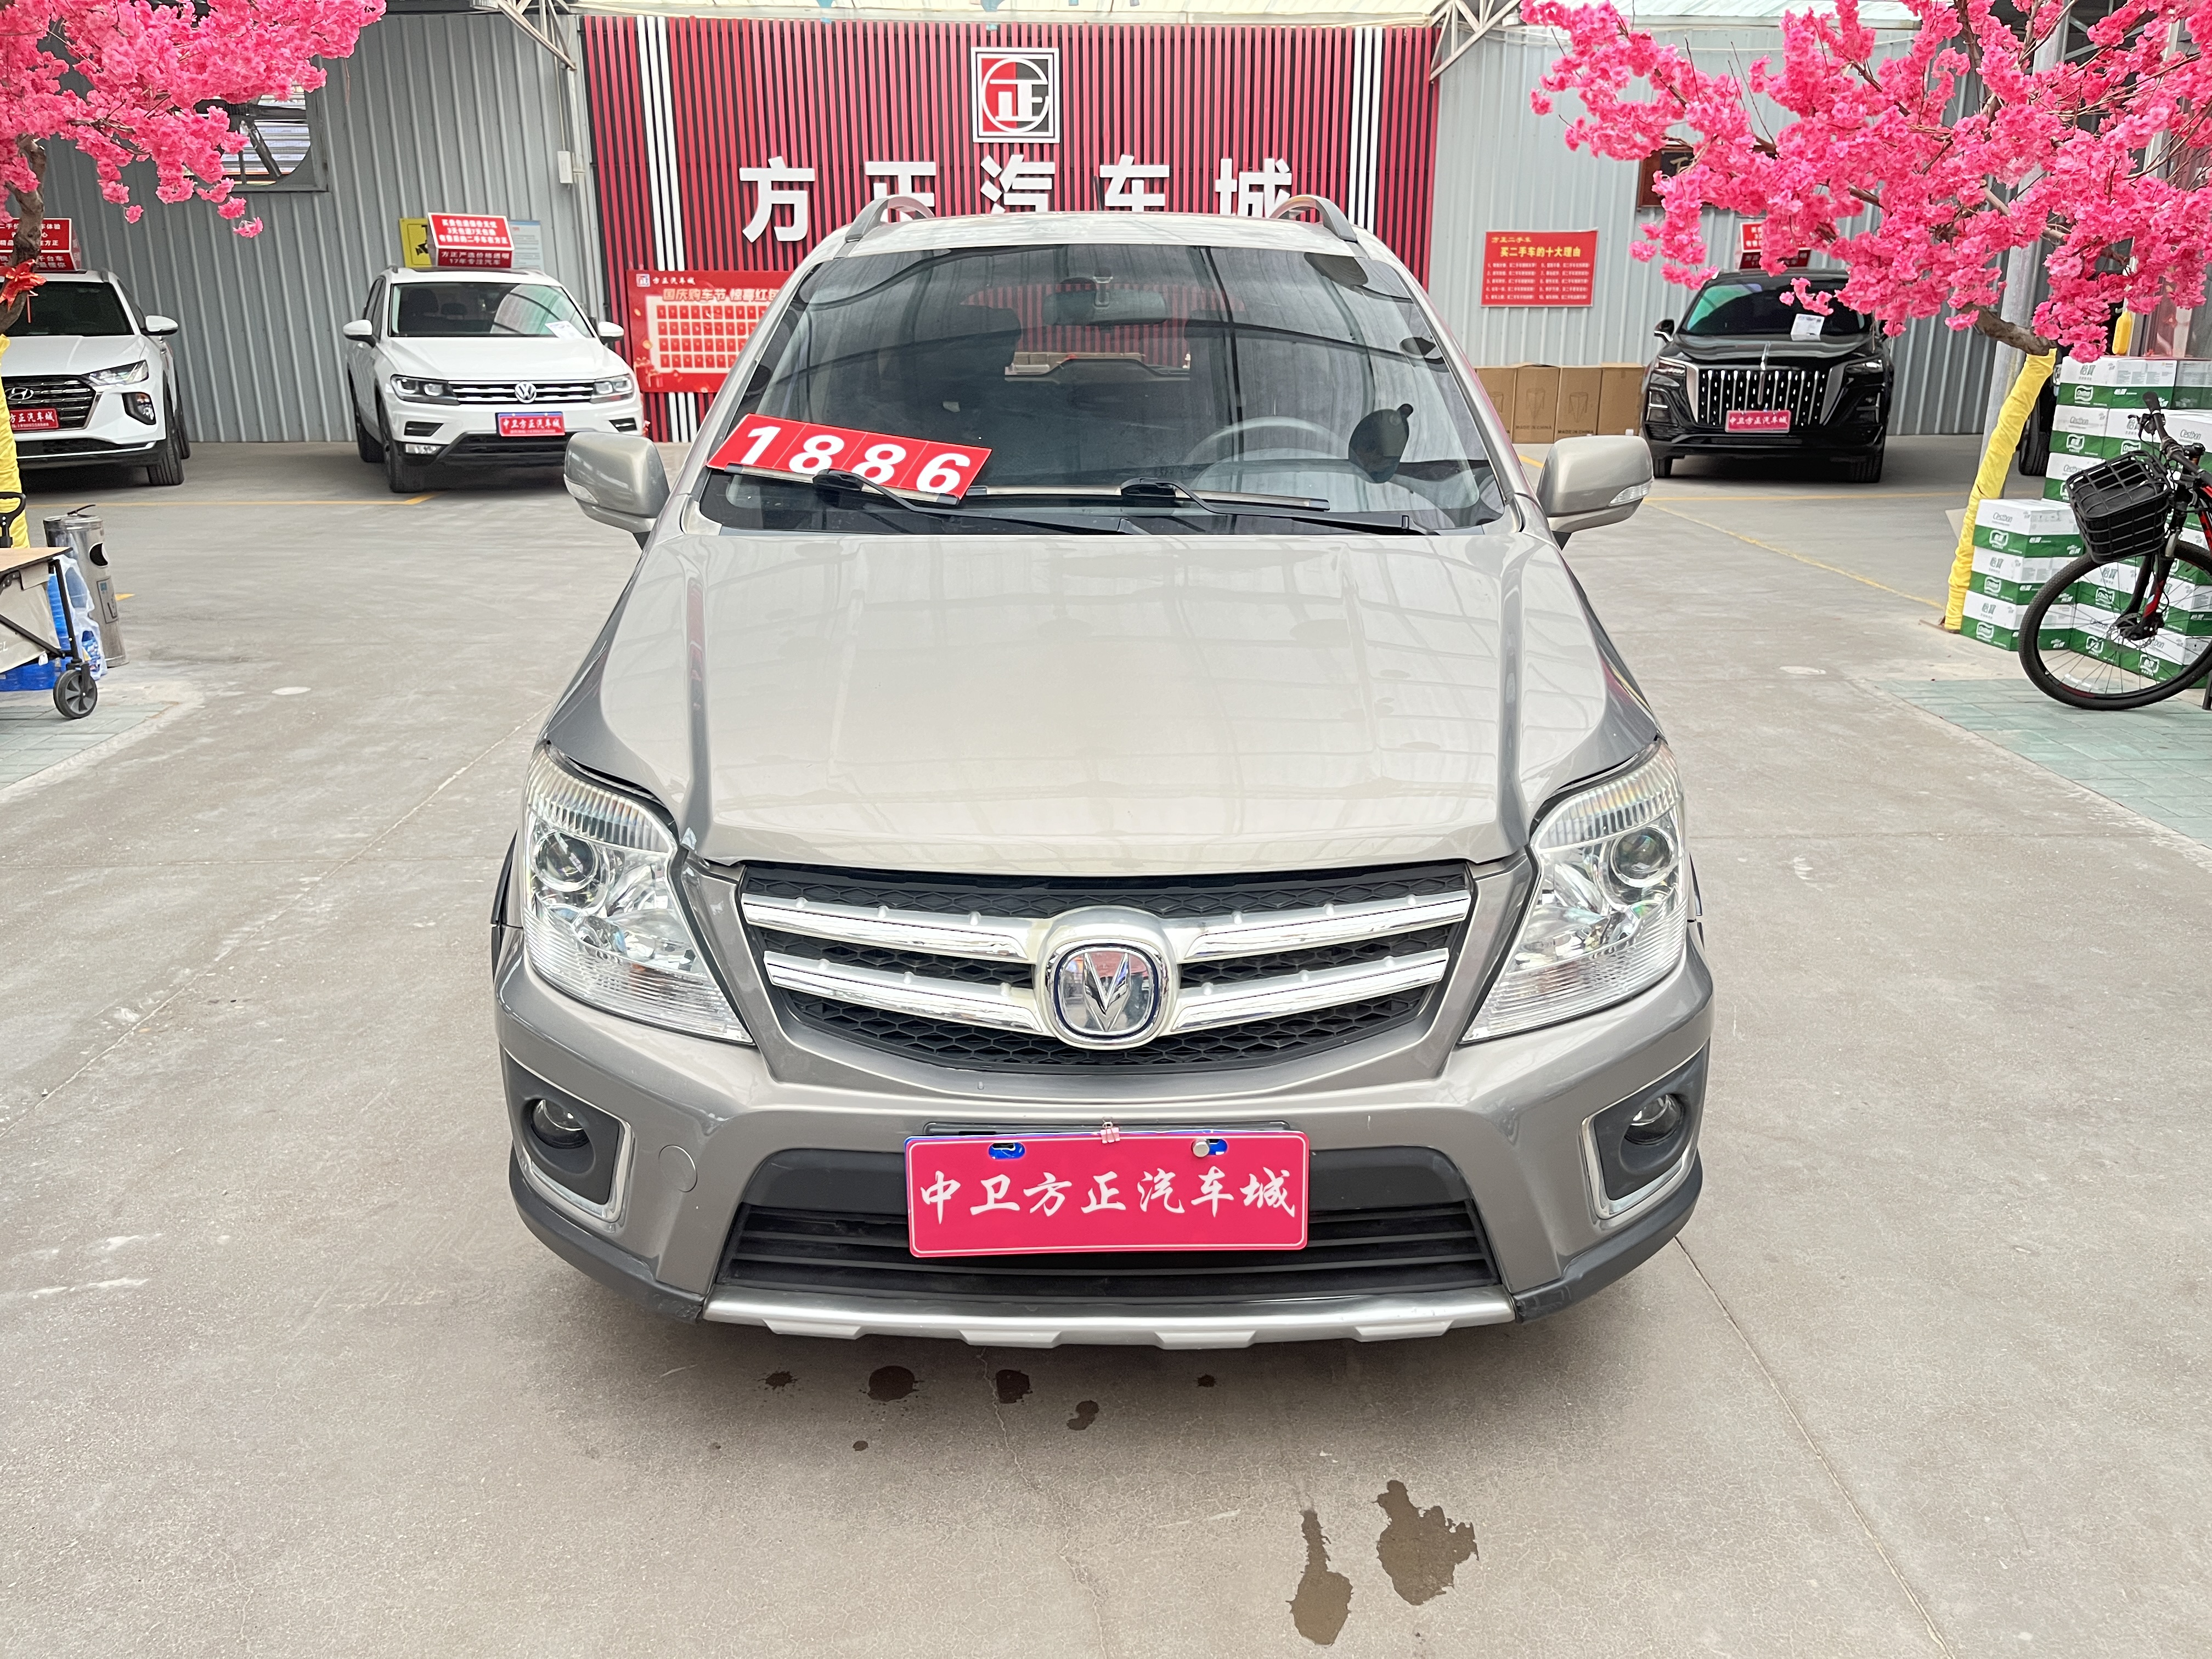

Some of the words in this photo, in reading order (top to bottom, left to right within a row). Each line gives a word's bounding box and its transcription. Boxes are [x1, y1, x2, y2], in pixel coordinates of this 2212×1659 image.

[740, 154, 1292, 242] 方正汽车城
[1500, 246, 1581, 257] 买二手车的十大理由
[663, 289, 726, 301] 国庆购车节
[740, 426, 970, 494] 1886
[921, 1167, 1295, 1224] 中卫方正汽车城
